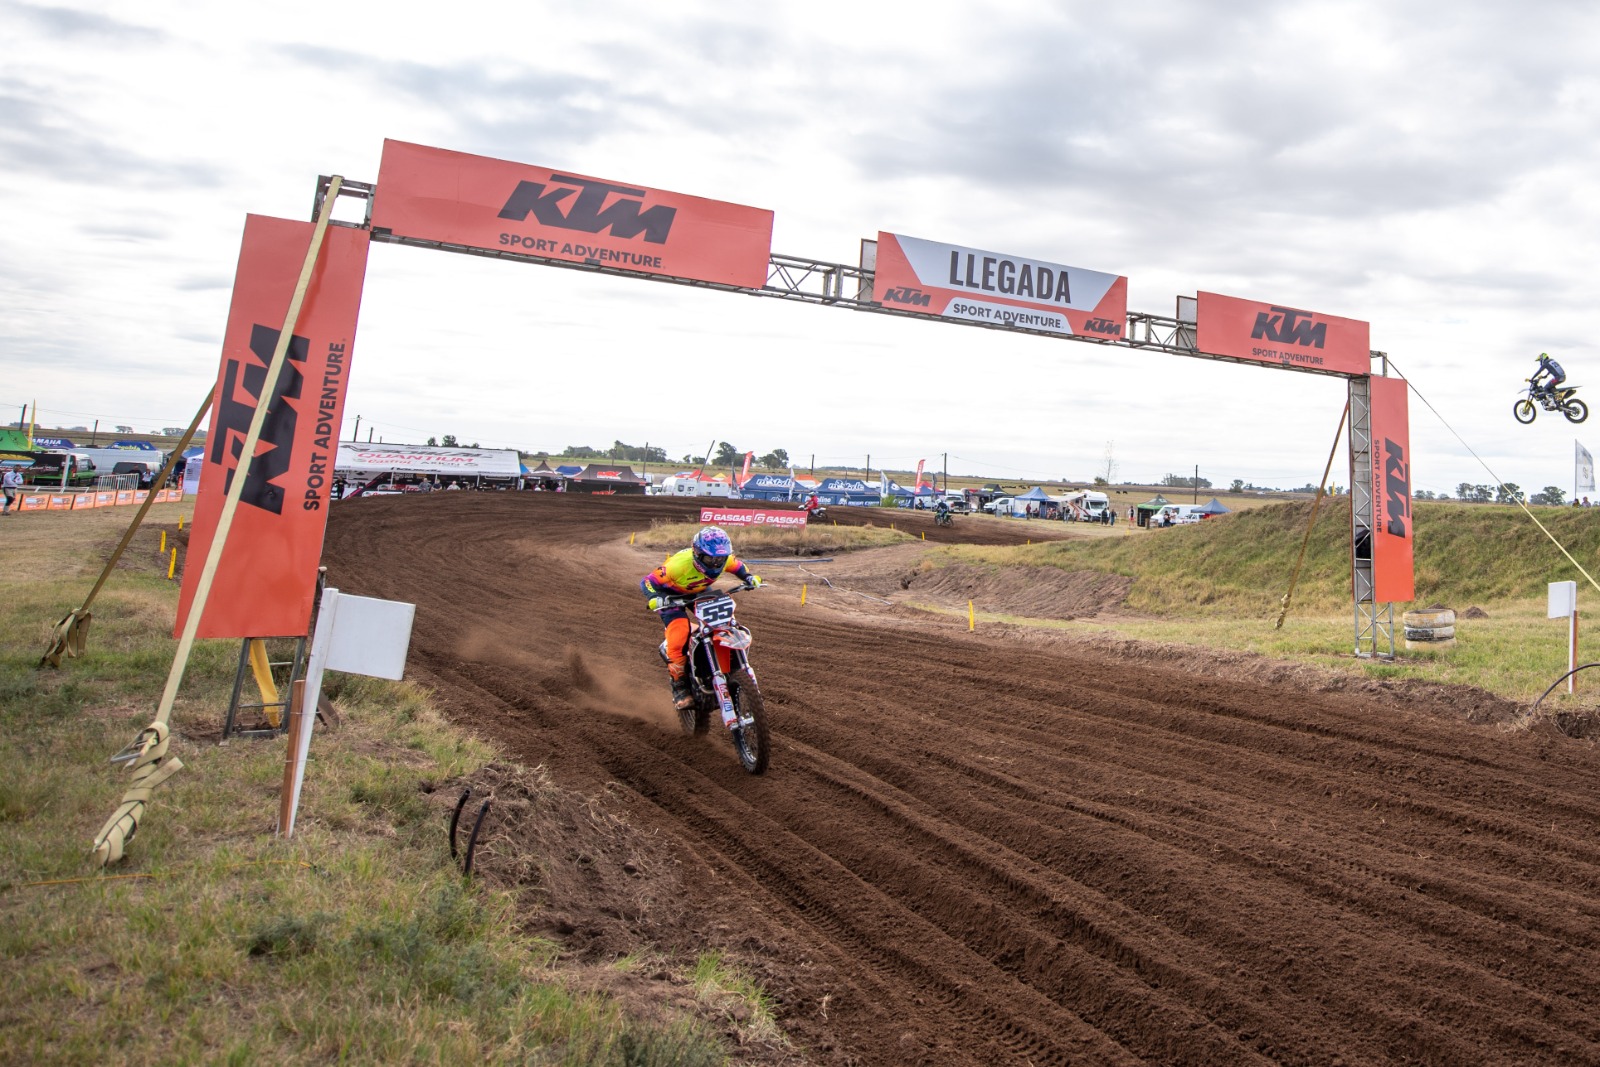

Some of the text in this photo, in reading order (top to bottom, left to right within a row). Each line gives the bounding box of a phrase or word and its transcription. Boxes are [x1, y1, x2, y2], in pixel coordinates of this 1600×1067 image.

[497, 173, 677, 245] KTM
[498, 233, 661, 269] SPORT ADVENTURE
[949, 250, 1072, 304] LLEGADA
[883, 286, 931, 307] KTM
[953, 303, 1061, 329] SPORT ADVENTURE
[1083, 317, 1121, 336] KTM
[1250, 306, 1327, 349] KTM
[1252, 347, 1324, 365] SPORT ADVENTURE
[210, 323, 310, 516] KTM
[303, 342, 345, 511] SPORT ADVENTURE
[357, 452, 474, 463] QUANTIUM
[1385, 437, 1410, 539] KTM
[713, 514, 752, 522] GASGAS
[766, 516, 806, 525] GASGAS
[703, 601, 733, 623] 55
